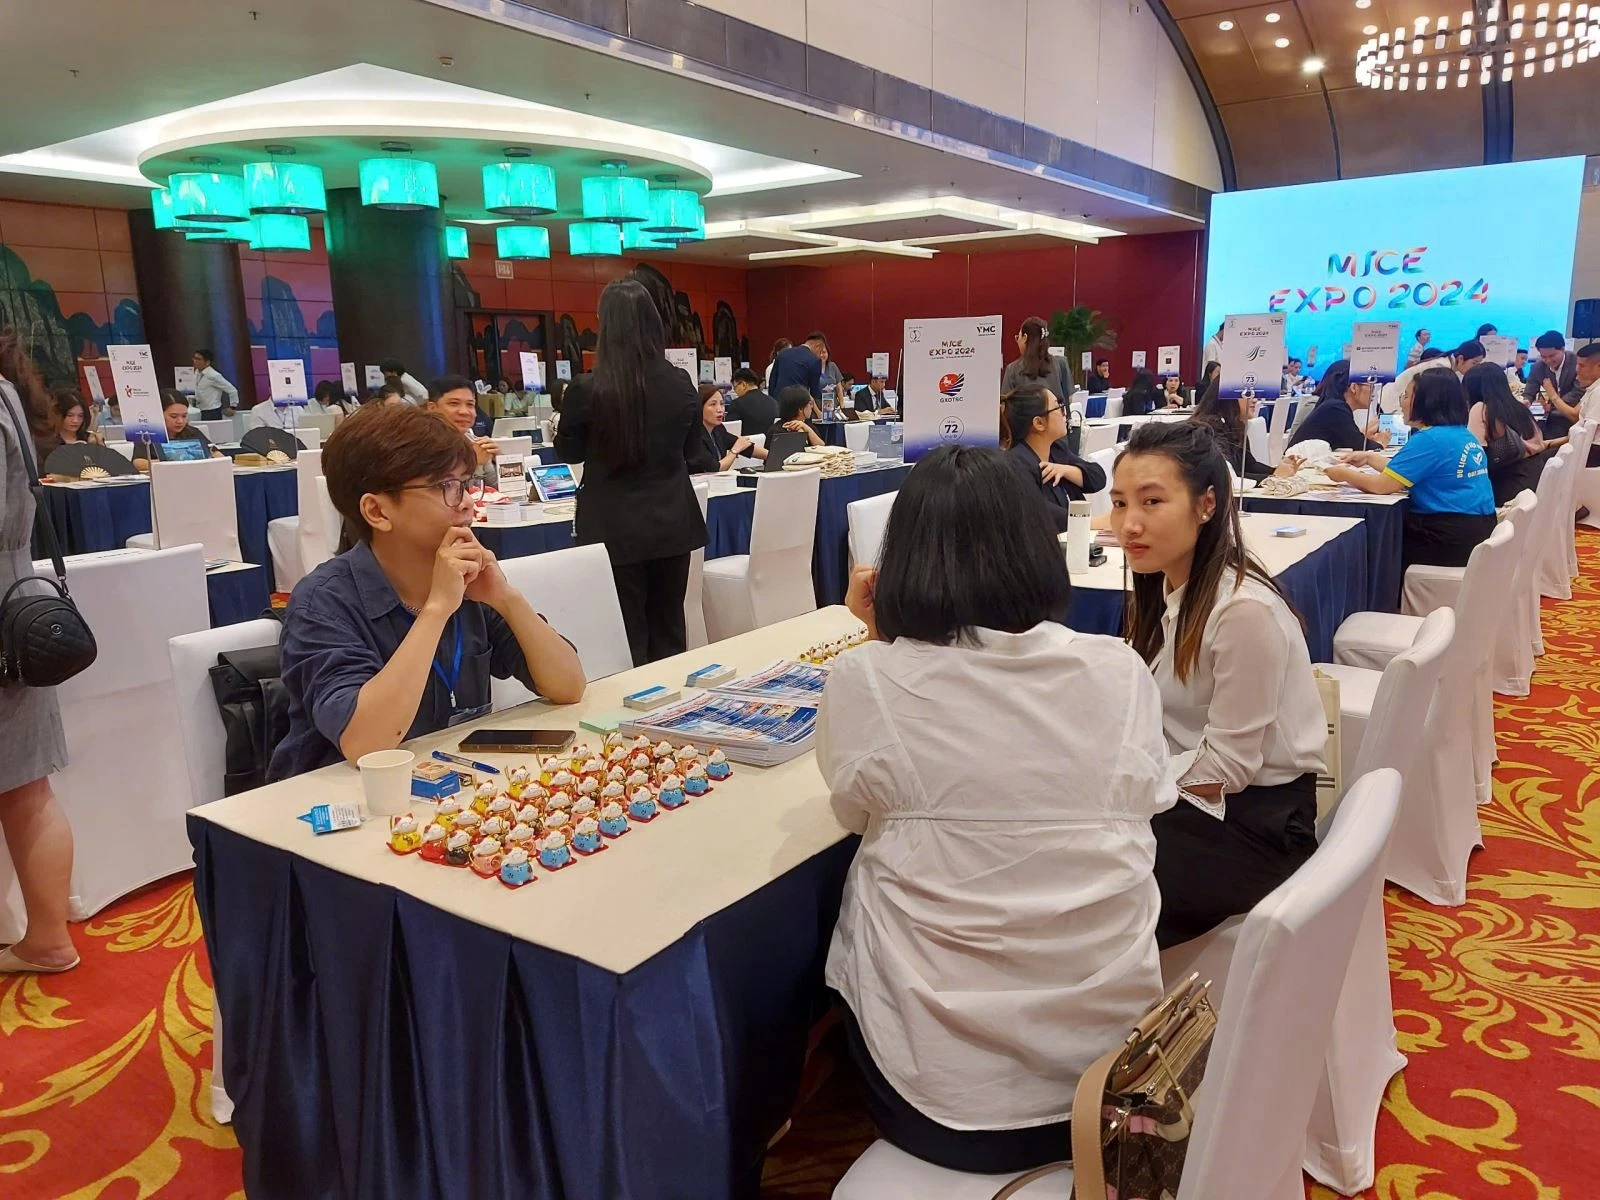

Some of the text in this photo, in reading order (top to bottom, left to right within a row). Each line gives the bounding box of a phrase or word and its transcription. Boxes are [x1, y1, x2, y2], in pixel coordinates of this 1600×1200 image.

[1328, 247, 1428, 278] MICE
[1268, 277, 1489, 313] EXPO 2024
[976, 325, 996, 333] VMC
[929, 347, 975, 356] EXPO 2024
[944, 424, 958, 433] 72
